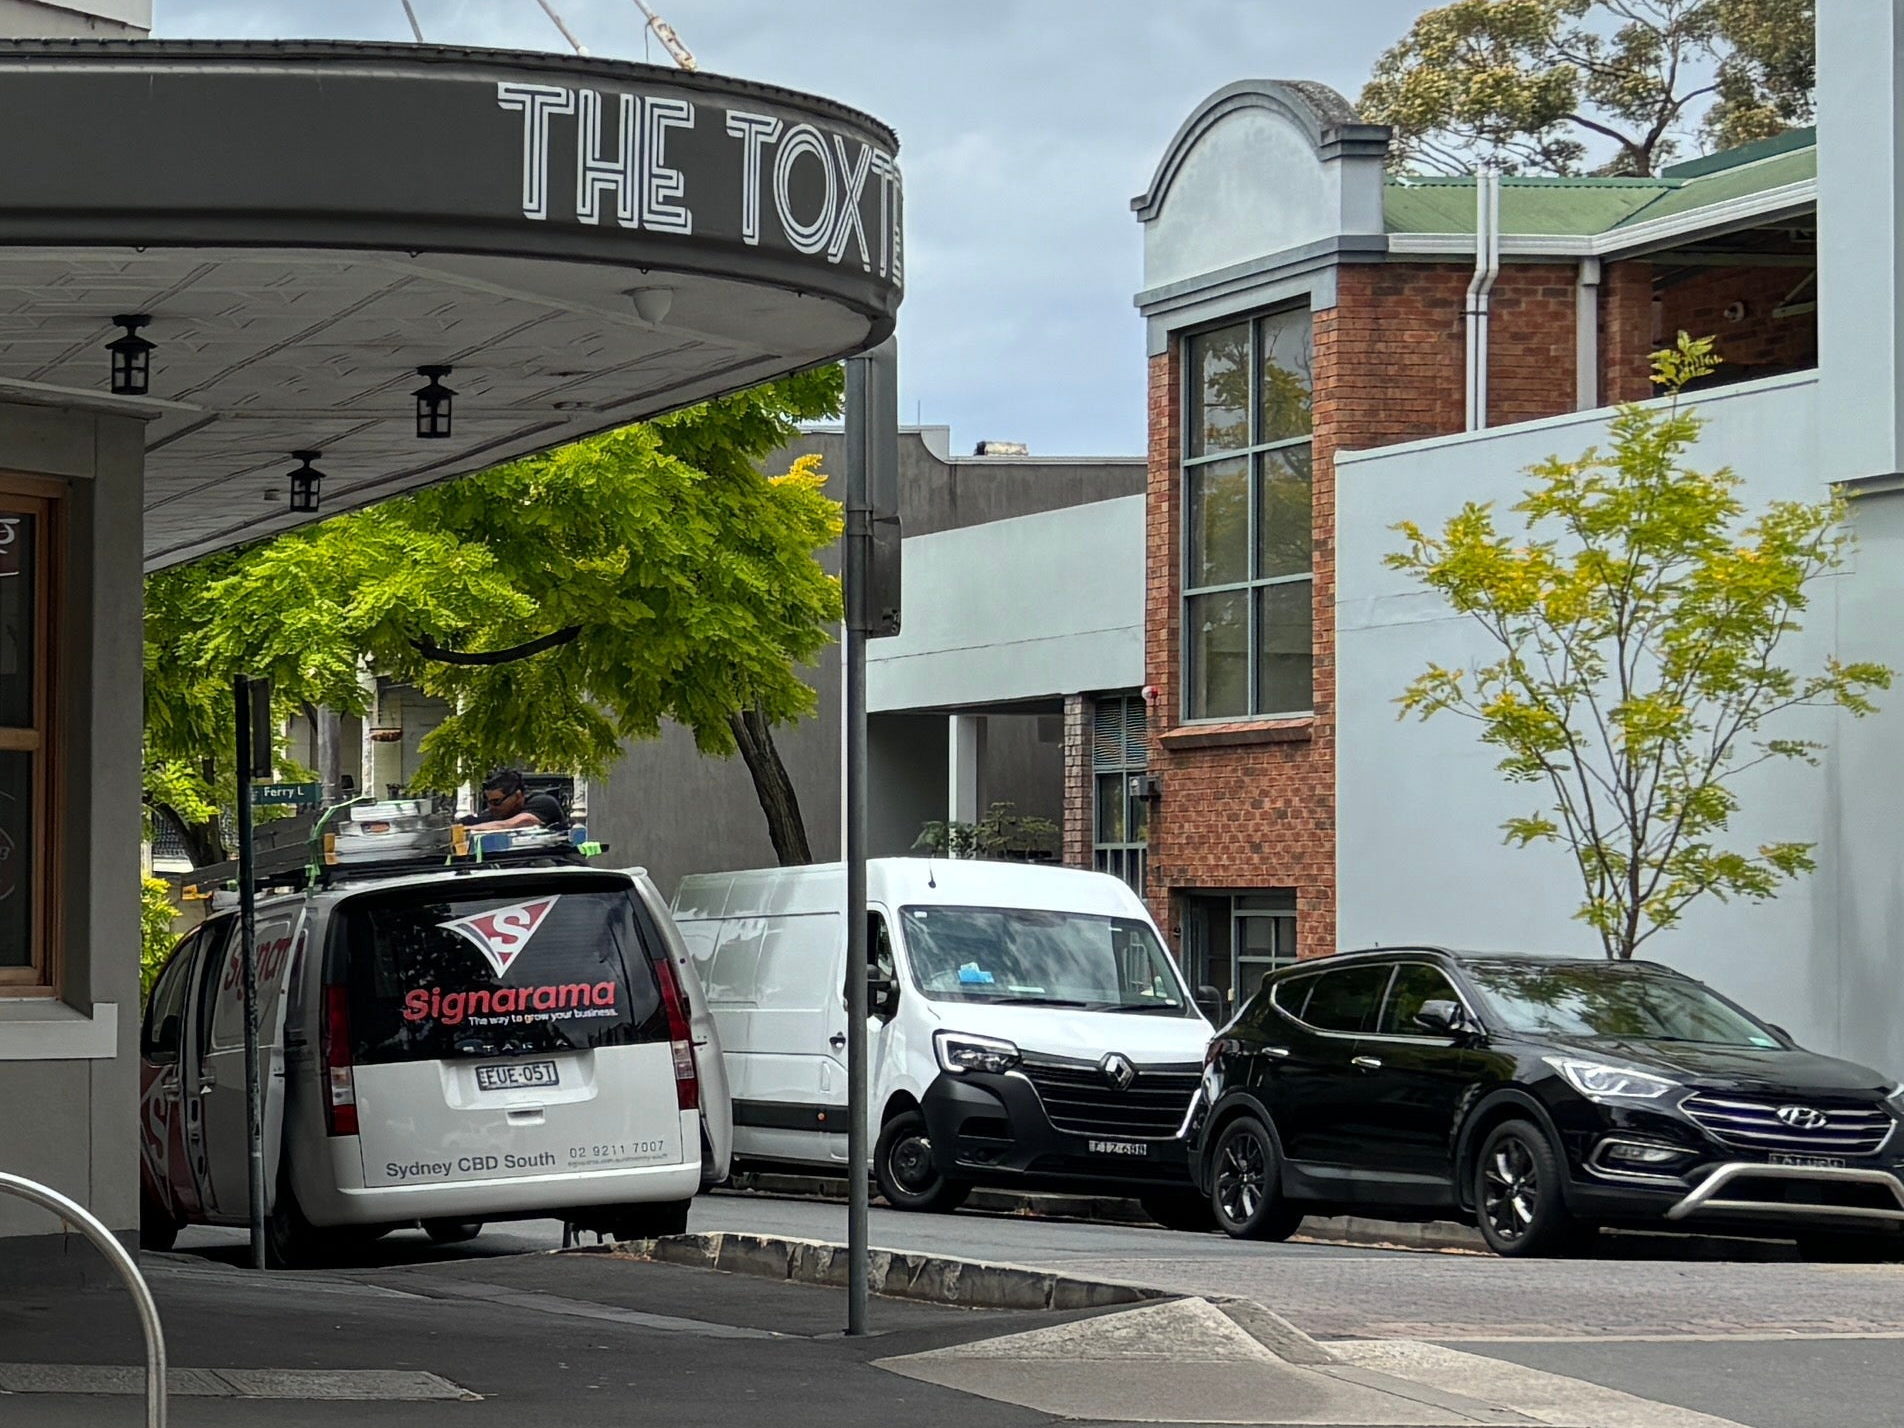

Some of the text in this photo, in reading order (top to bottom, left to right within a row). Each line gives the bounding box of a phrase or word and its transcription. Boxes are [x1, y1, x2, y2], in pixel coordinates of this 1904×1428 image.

[497, 81, 695, 236] THE
[264, 786, 294, 799] Ferry
[402, 980, 617, 1026] Signarama
[468, 1015, 488, 1026] The
[489, 1015, 510, 1026] way
[511, 1013, 523, 1023] to
[524, 1012, 549, 1024] grow
[550, 1010, 573, 1022] your
[569, 1140, 664, 1158] 02 9211 7007
[386, 1161, 452, 1180] Sydney
[458, 1155, 499, 1172] CBD
[504, 1151, 556, 1169] South
